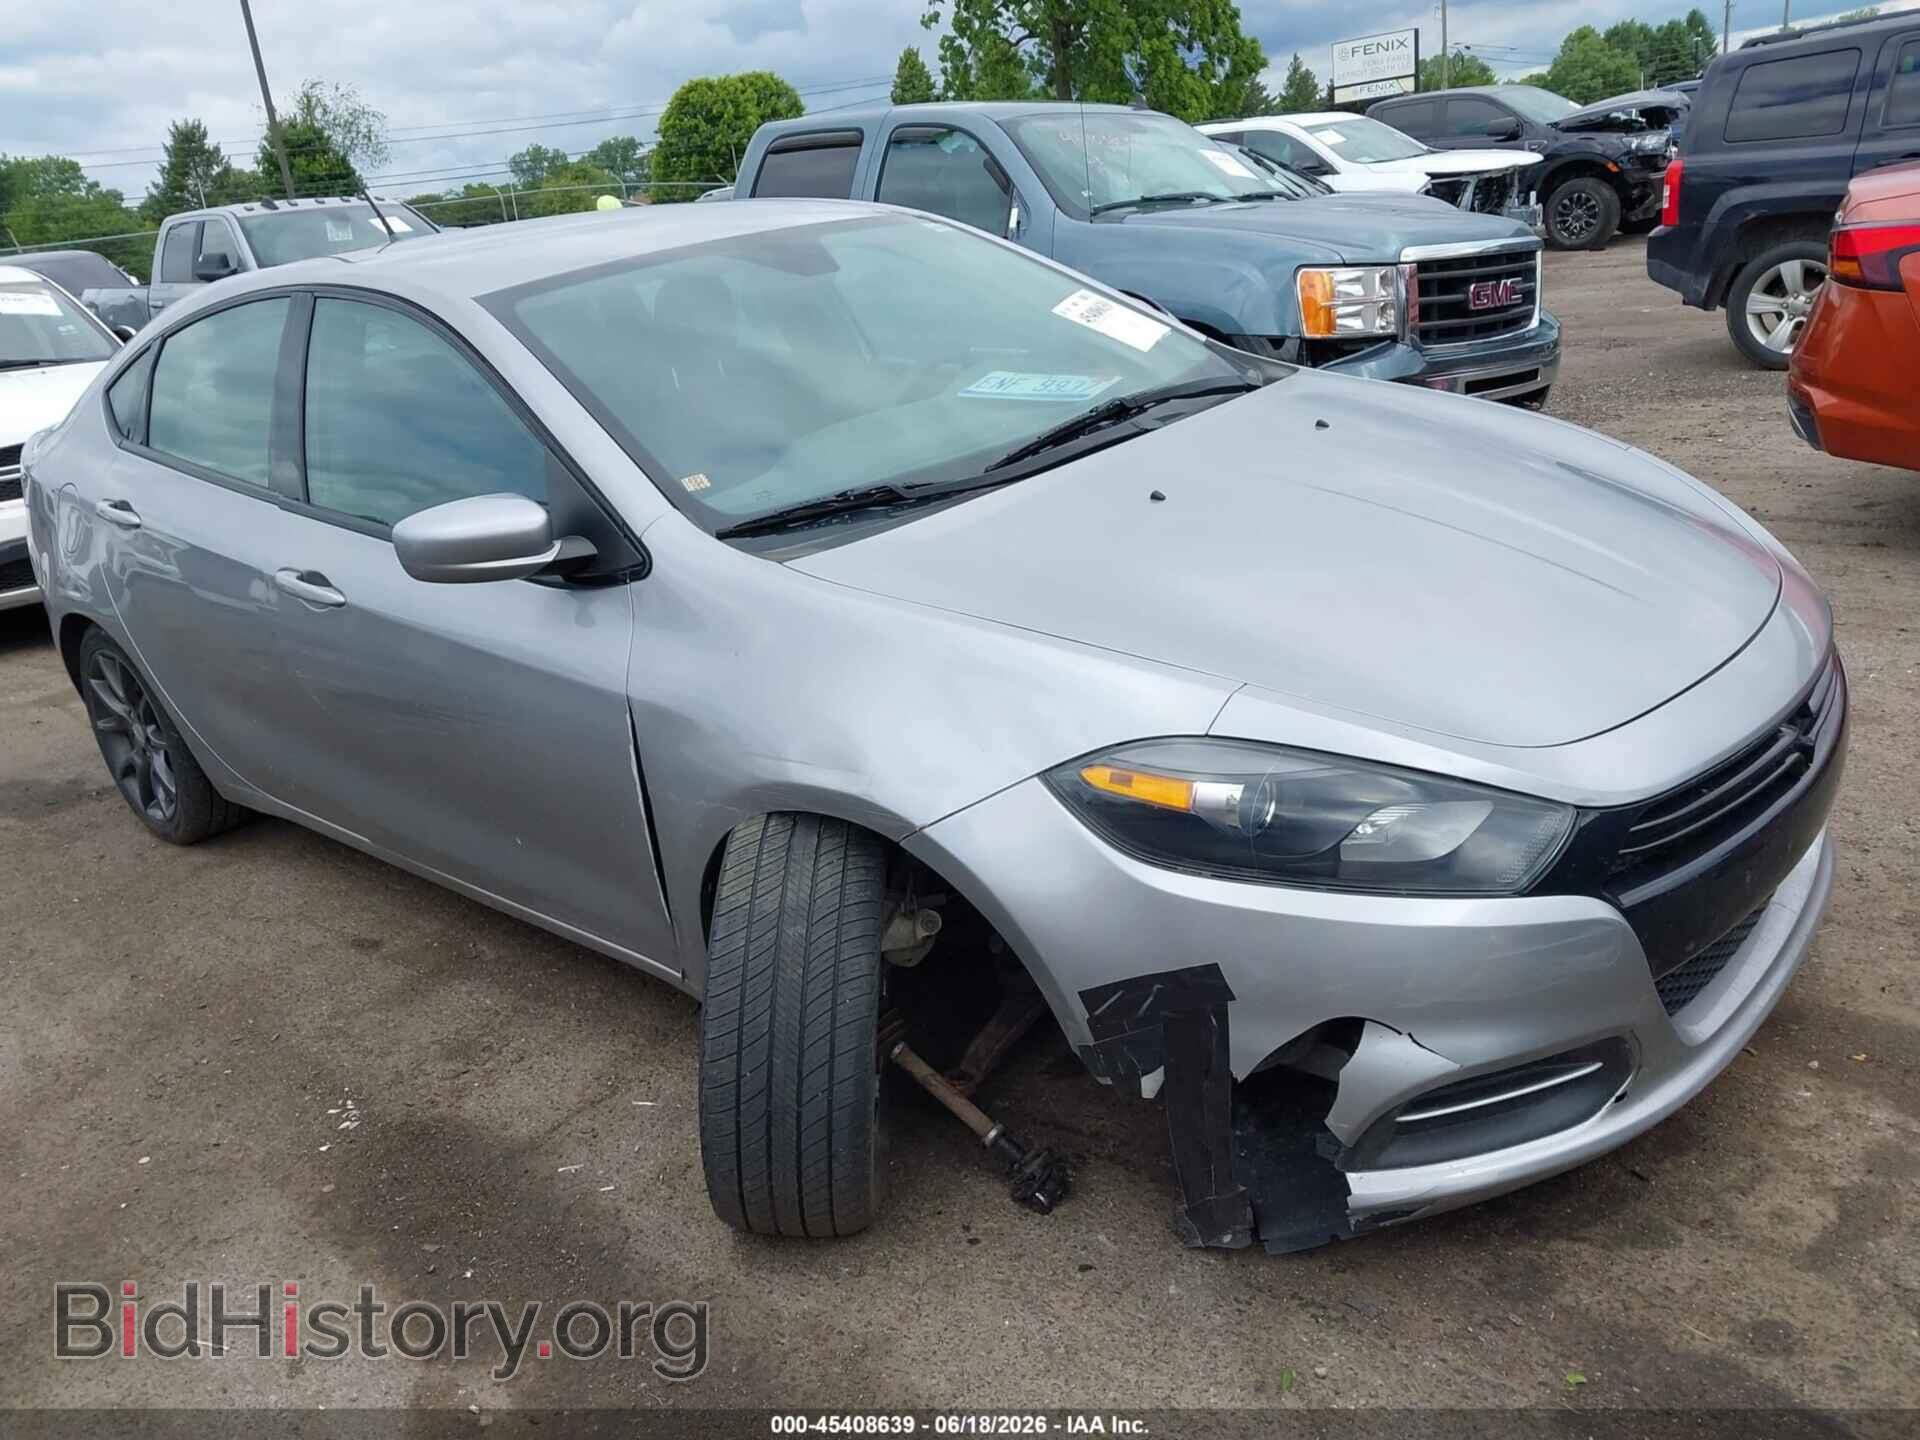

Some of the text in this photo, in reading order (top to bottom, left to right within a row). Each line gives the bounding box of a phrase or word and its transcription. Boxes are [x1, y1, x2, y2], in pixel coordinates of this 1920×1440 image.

[1351, 37, 1408, 57] FENIX
[1360, 81, 1395, 93] FENIX
[1469, 277, 1522, 310] GMC
